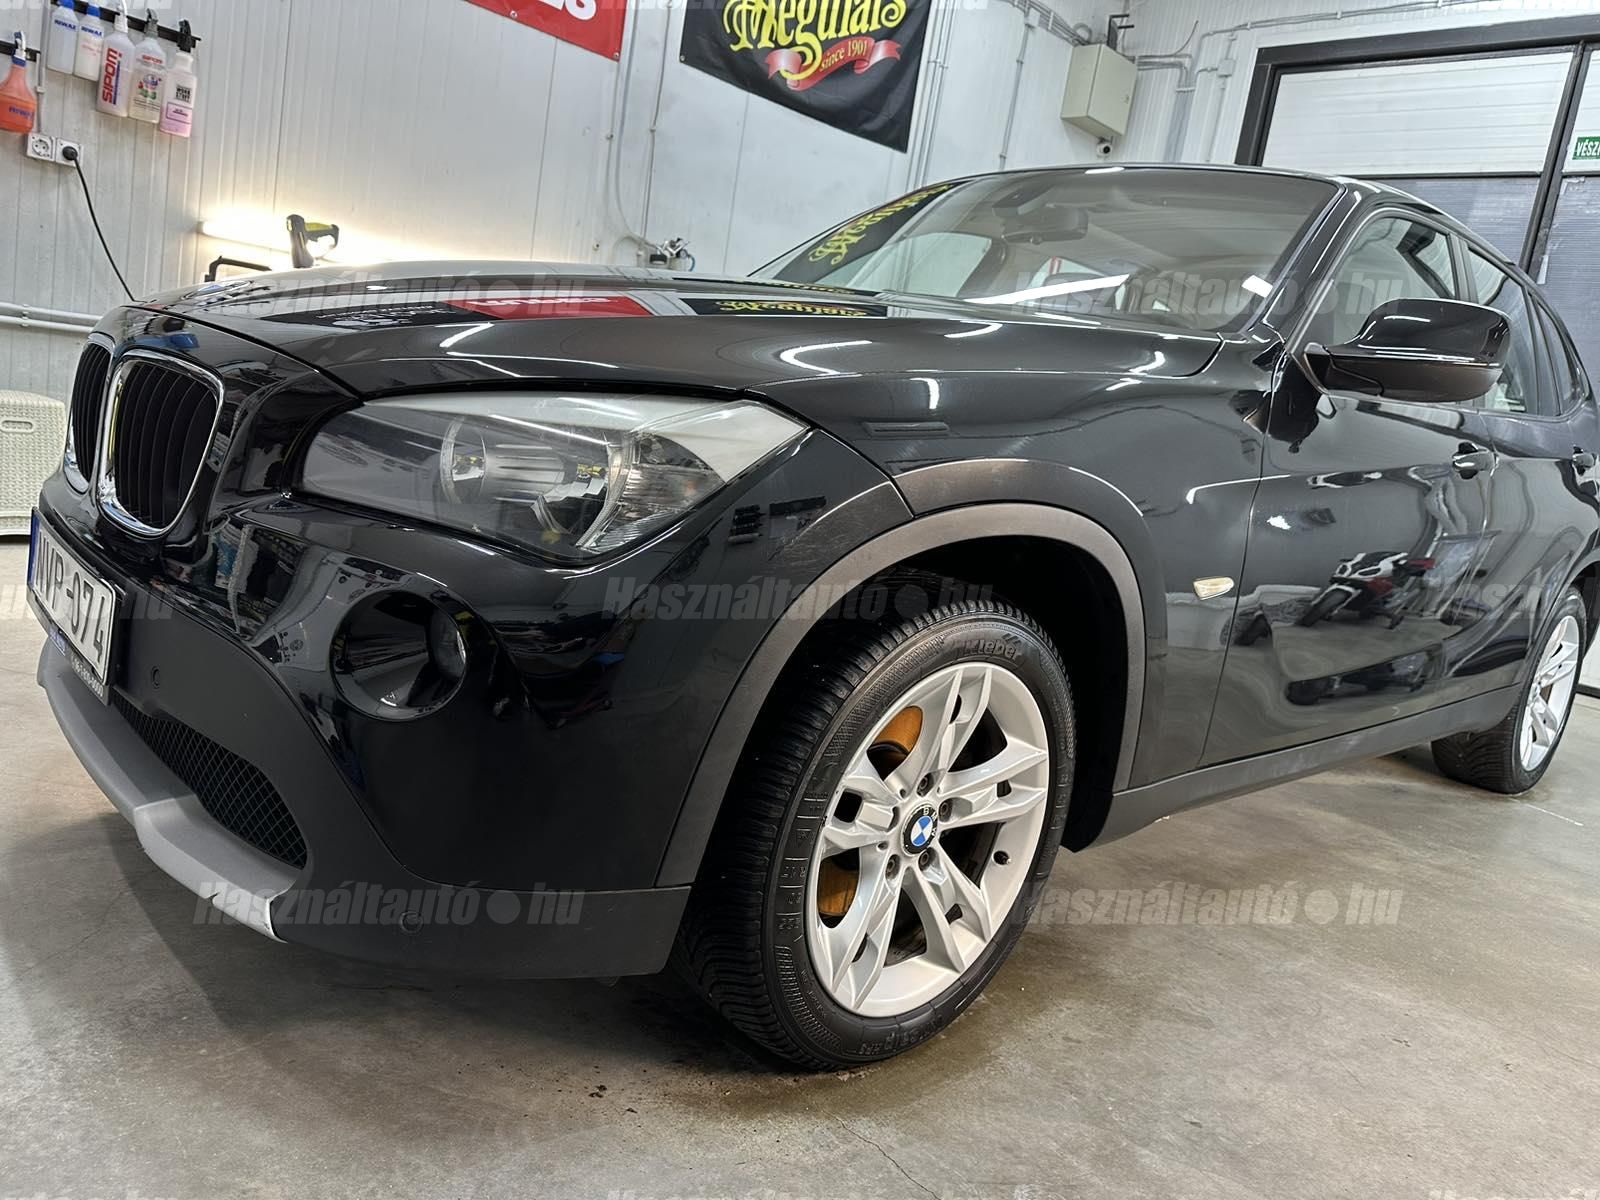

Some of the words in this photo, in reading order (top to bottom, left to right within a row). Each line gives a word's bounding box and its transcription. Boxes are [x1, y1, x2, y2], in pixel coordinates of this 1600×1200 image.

[819, 48, 844, 72] since
[847, 41, 867, 57] 1901
[1577, 139, 1600, 157] VÉSZ
[35, 531, 106, 664] NVP-074
[958, 639, 1022, 660] Kleber
